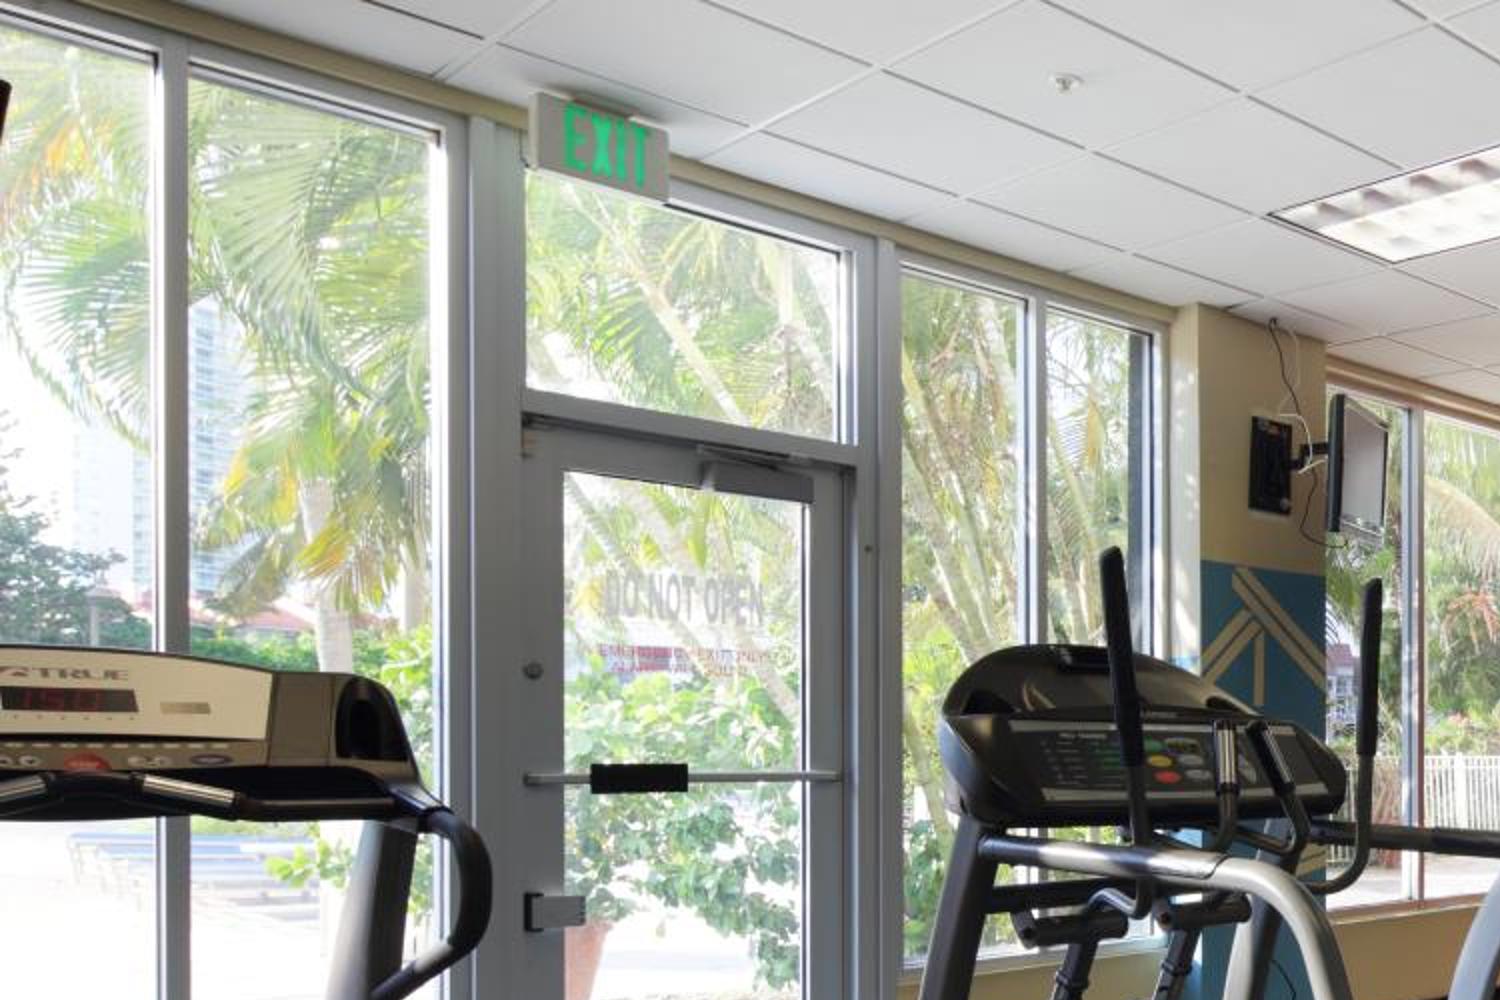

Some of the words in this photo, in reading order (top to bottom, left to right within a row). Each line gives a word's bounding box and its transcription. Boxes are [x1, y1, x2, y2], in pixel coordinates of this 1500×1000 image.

[564, 102, 647, 190] EXIT
[606, 570, 639, 618] DO
[649, 573, 697, 622] NOT
[704, 576, 764, 626] OPEN
[32, 667, 129, 681] TRUE
